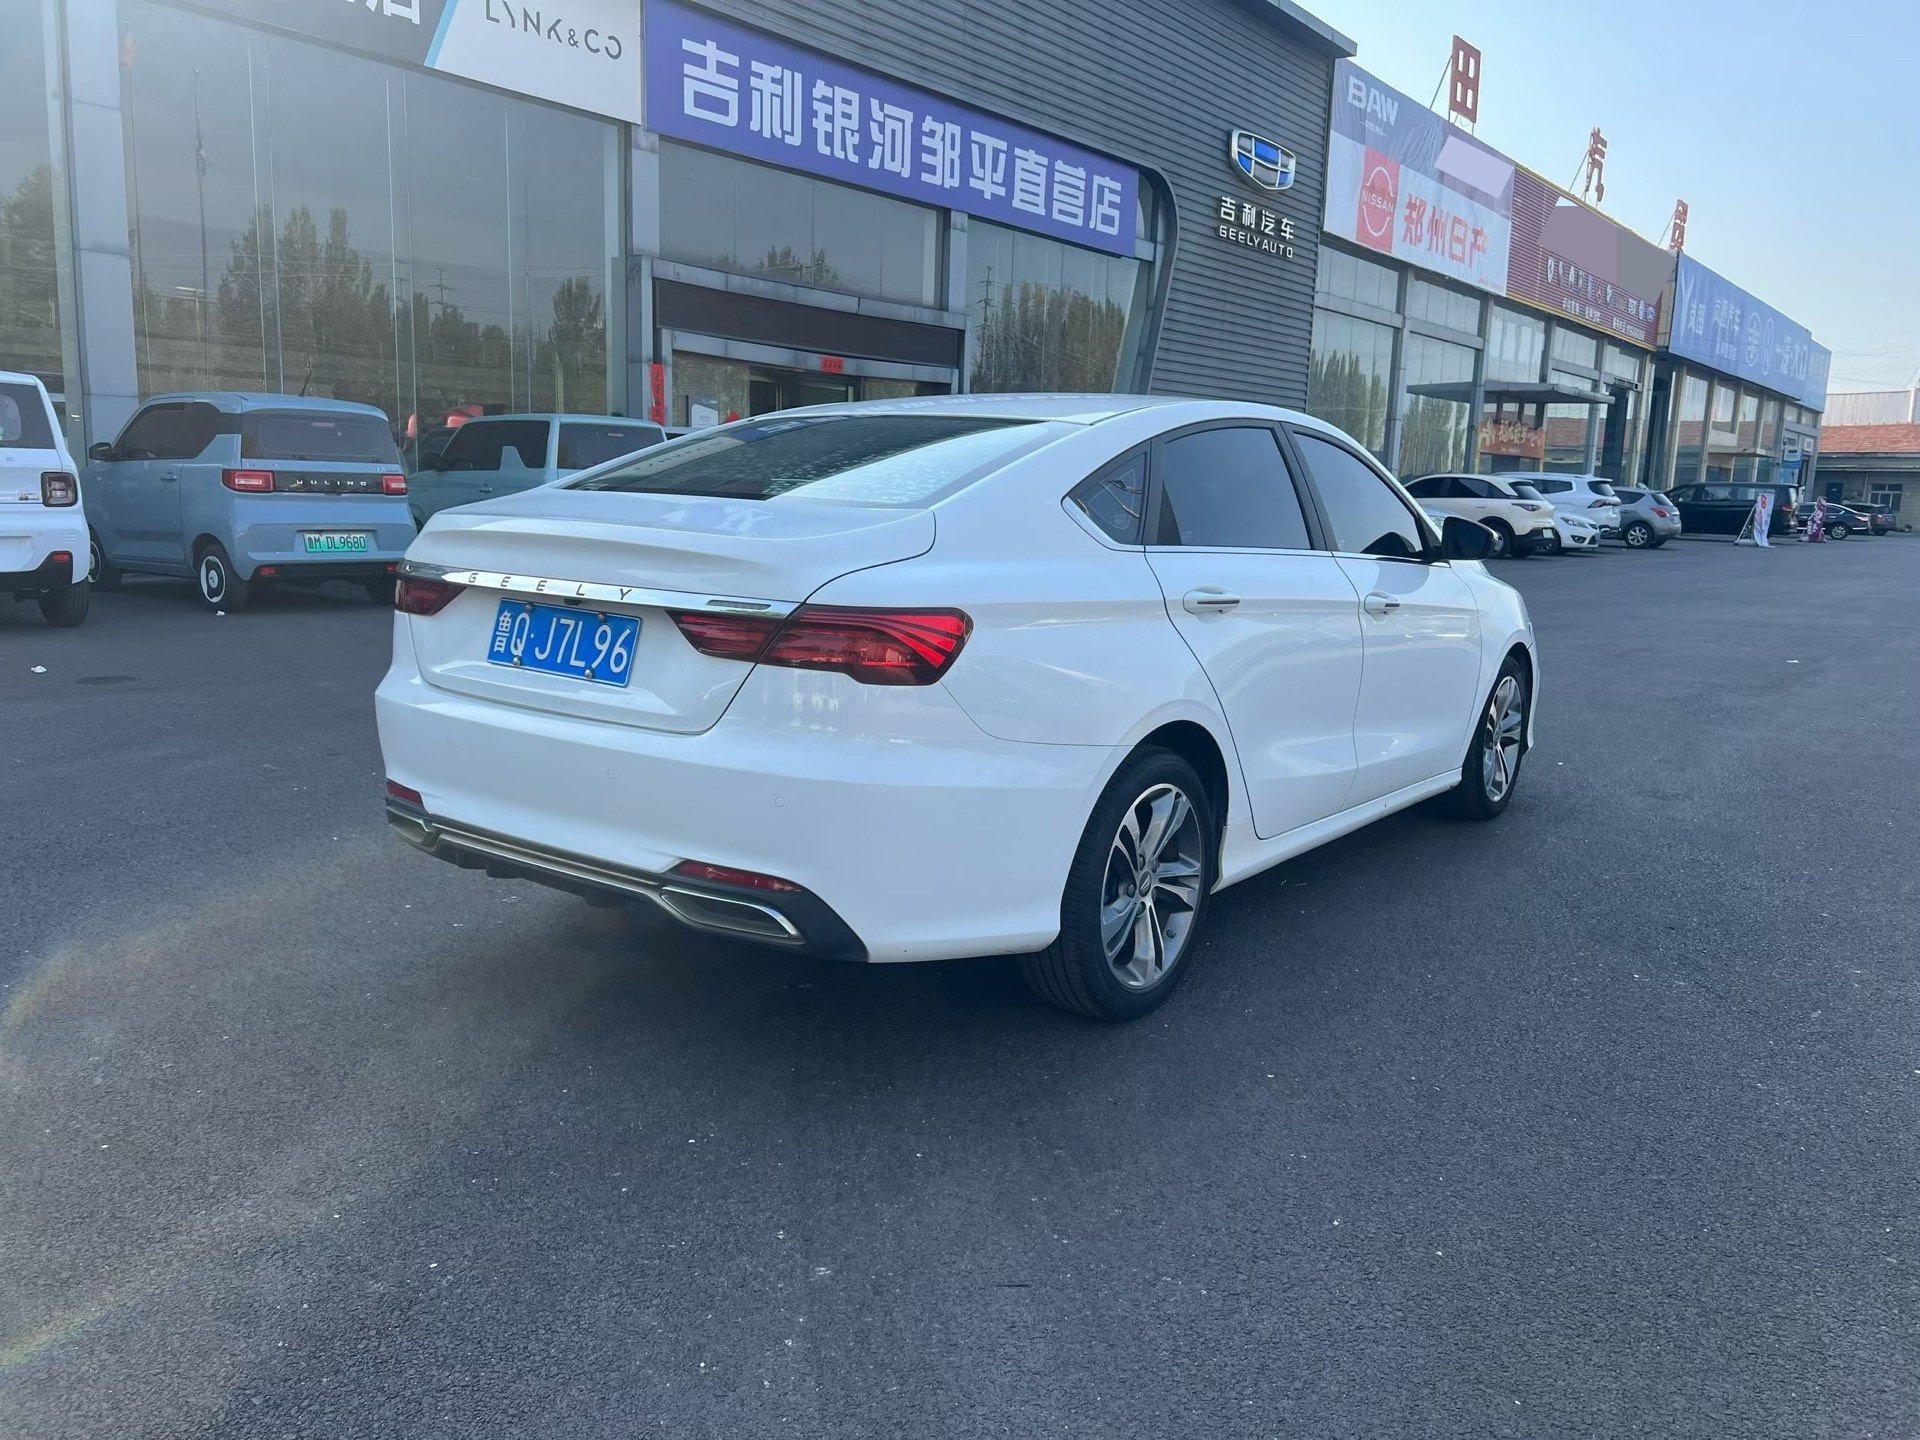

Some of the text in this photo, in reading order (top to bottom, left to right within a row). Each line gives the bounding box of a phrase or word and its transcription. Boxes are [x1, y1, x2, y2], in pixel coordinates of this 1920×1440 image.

[1347, 75, 1399, 126] BAW
[682, 38, 1122, 236] 吉利银河邹平直营店
[1220, 196, 1294, 240] 吉利汽车
[1361, 190, 1394, 214] NISSAN
[1402, 193, 1488, 269] 郑州日产
[296, 479, 367, 487] WULING
[467, 572, 632, 601] GEELY
